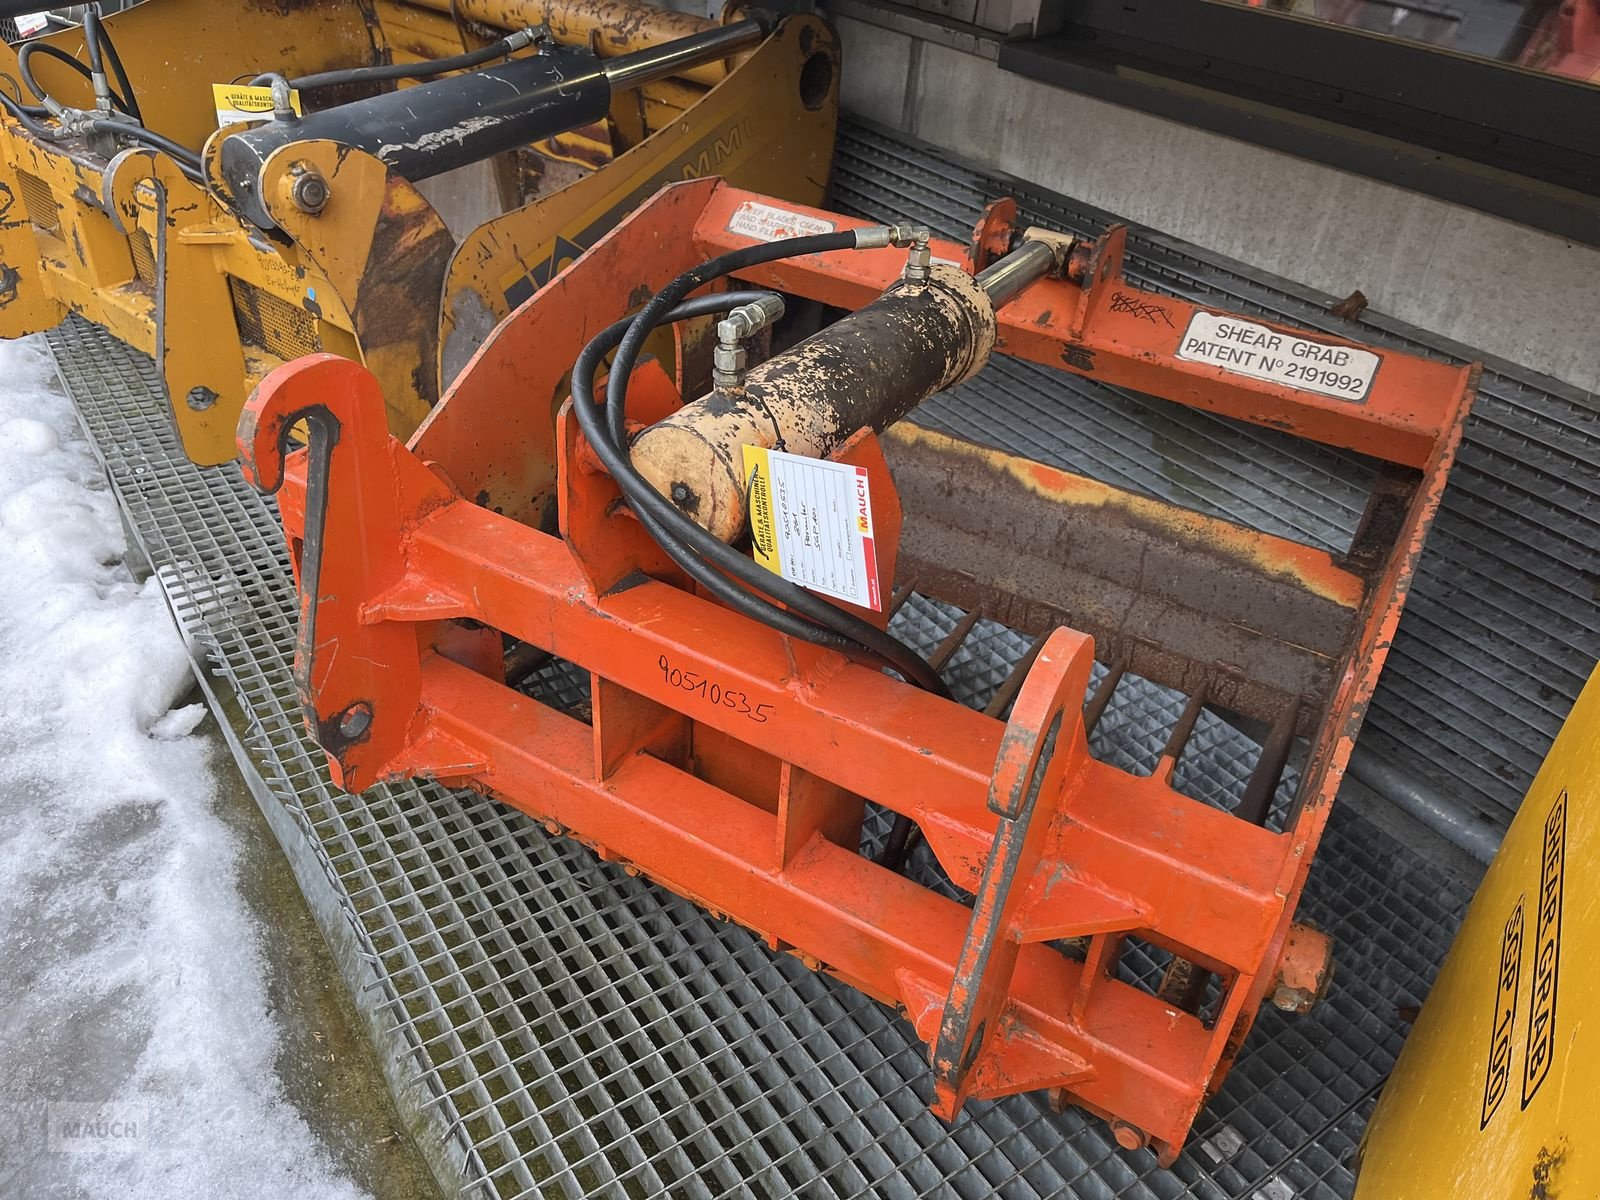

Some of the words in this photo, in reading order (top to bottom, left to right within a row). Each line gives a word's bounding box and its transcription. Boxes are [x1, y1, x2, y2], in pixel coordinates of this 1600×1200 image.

[1185, 338, 1257, 366] PATENT
[1285, 362, 1364, 394] 2191992
[1215, 323, 1282, 351] SHEAR
[1291, 341, 1350, 367] GRAB
[857, 479, 869, 529] MAUCH
[659, 655, 774, 722] 90510535
[1543, 803, 1563, 932] SHEAR
[1502, 903, 1522, 992] SGP
[1530, 940, 1553, 1081] GRAB
[1488, 1008, 1512, 1105] 100
